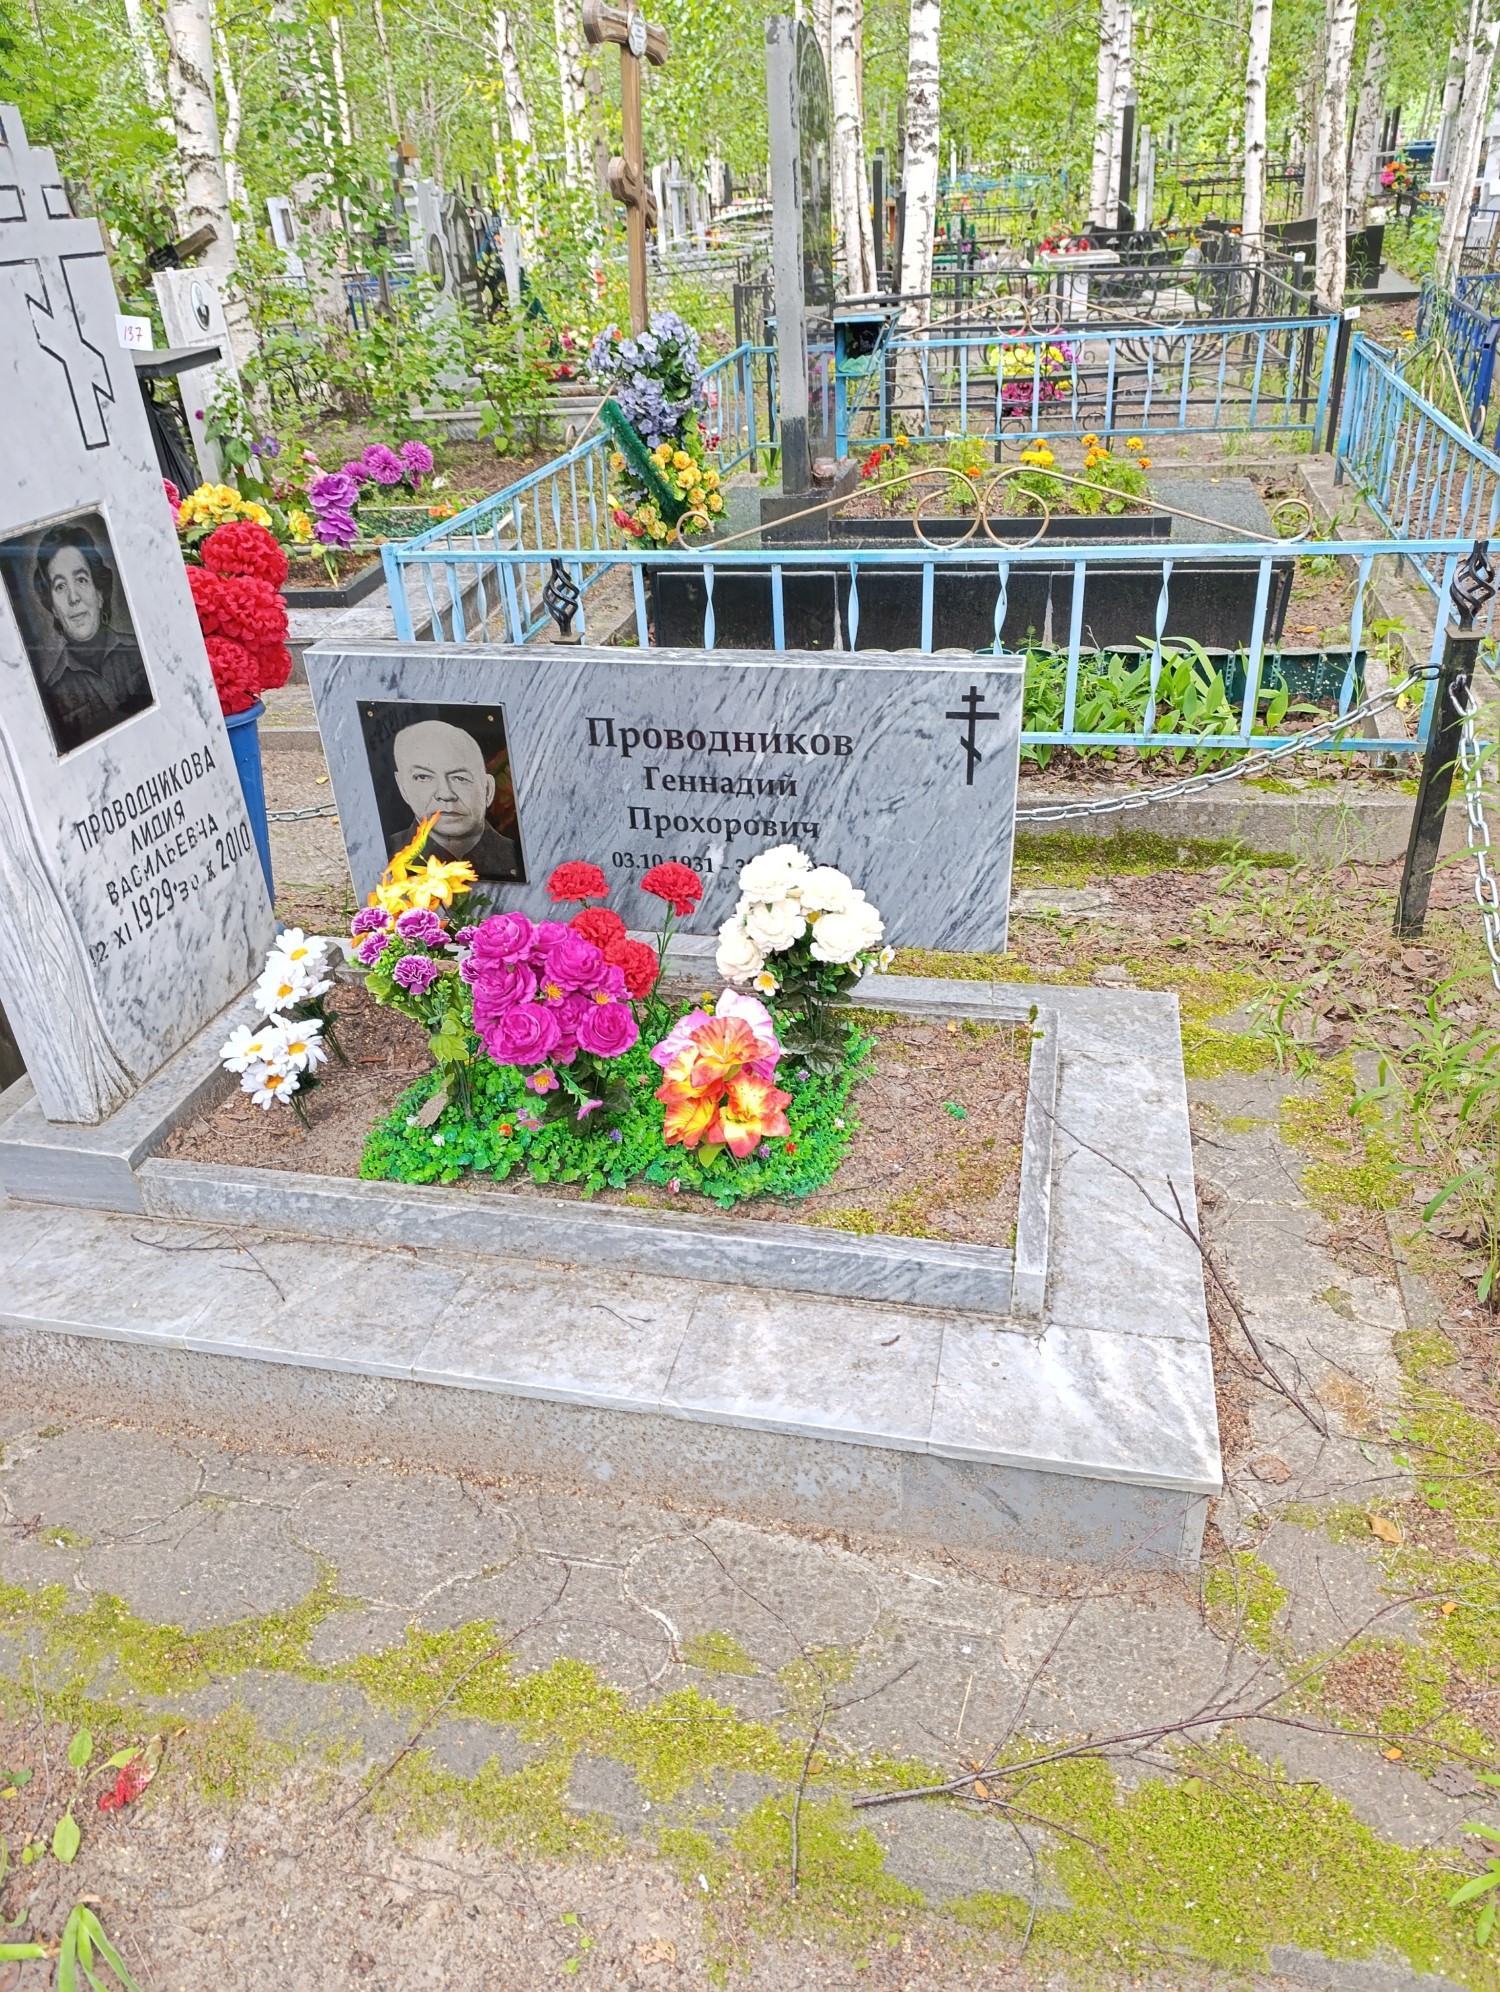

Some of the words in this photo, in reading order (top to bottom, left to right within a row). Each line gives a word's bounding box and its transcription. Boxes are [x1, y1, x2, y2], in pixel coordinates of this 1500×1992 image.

[124, 325, 143, 342] 137
[586, 716, 853, 758] Проводников
[76, 745, 216, 852] ПРОВОДНИКОВА
[643, 766, 797, 799] Геннадий
[130, 800, 185, 856] ЛИДИЯ
[215, 822, 250, 871] 2010
[627, 806, 820, 842] Прохорович
[105, 813, 219, 905] ВАСИЛЬЕВНА
